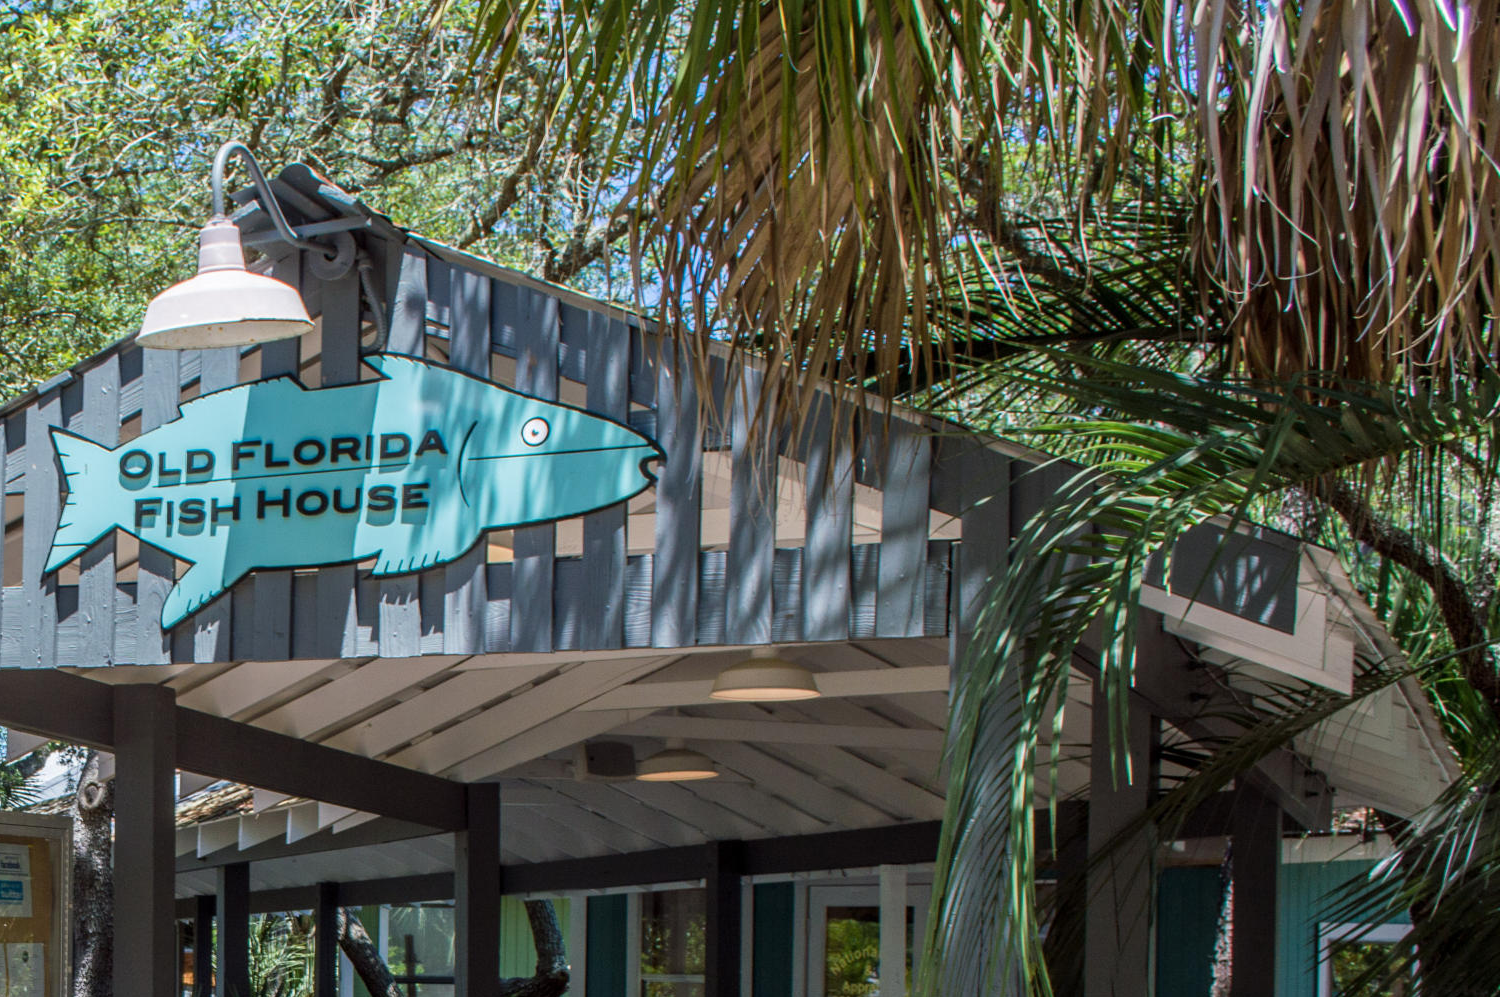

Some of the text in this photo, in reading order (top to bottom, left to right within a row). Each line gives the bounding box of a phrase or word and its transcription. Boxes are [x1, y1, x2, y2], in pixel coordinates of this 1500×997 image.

[119, 429, 448, 480] OLD FLORIDA
[134, 483, 431, 529] FISH HOUSE
[830, 945, 879, 976] Nationa
[841, 981, 879, 996] Appra
